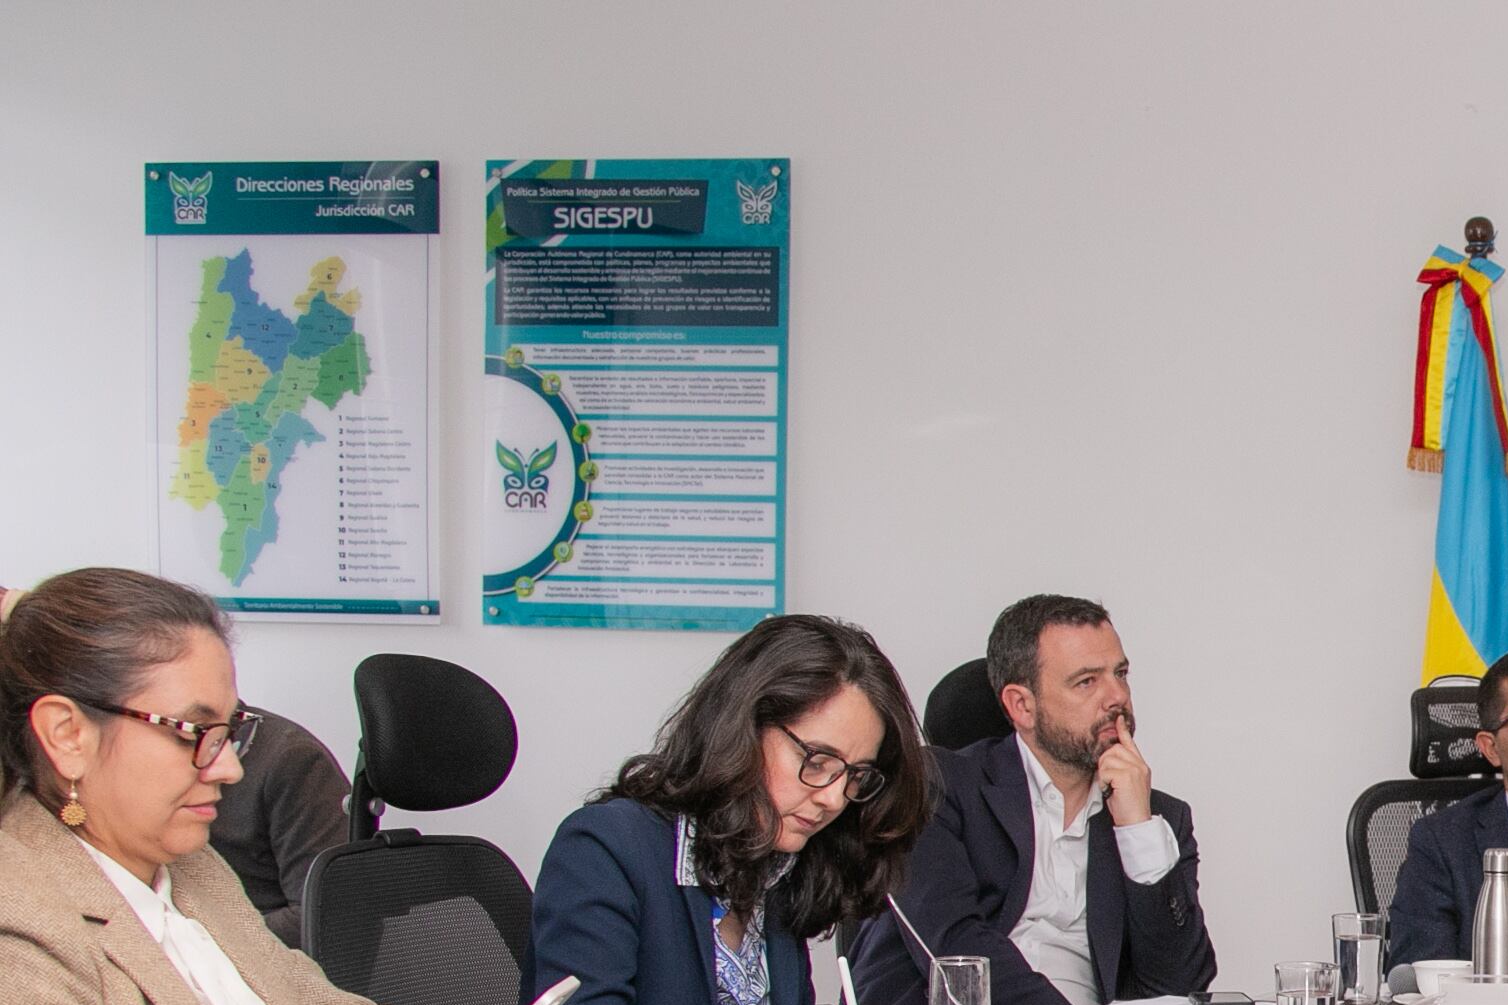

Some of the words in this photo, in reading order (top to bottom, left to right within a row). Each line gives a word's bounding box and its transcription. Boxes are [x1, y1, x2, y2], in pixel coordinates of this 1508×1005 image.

[236, 177, 324, 193] Direcciones
[329, 176, 415, 195] Regionales
[507, 187, 538, 197] Política
[540, 187, 574, 197] Sistema
[576, 187, 618, 199] Integrado
[620, 187, 631, 197] de
[633, 186, 667, 197] Gestión
[668, 186, 700, 197] Pública
[176, 207, 205, 220] CAR
[316, 204, 385, 218] Jurisdicción
[388, 204, 415, 216] CAR
[553, 207, 654, 228] SIGESPU
[742, 212, 771, 224] CAR
[505, 491, 547, 508] CAR
